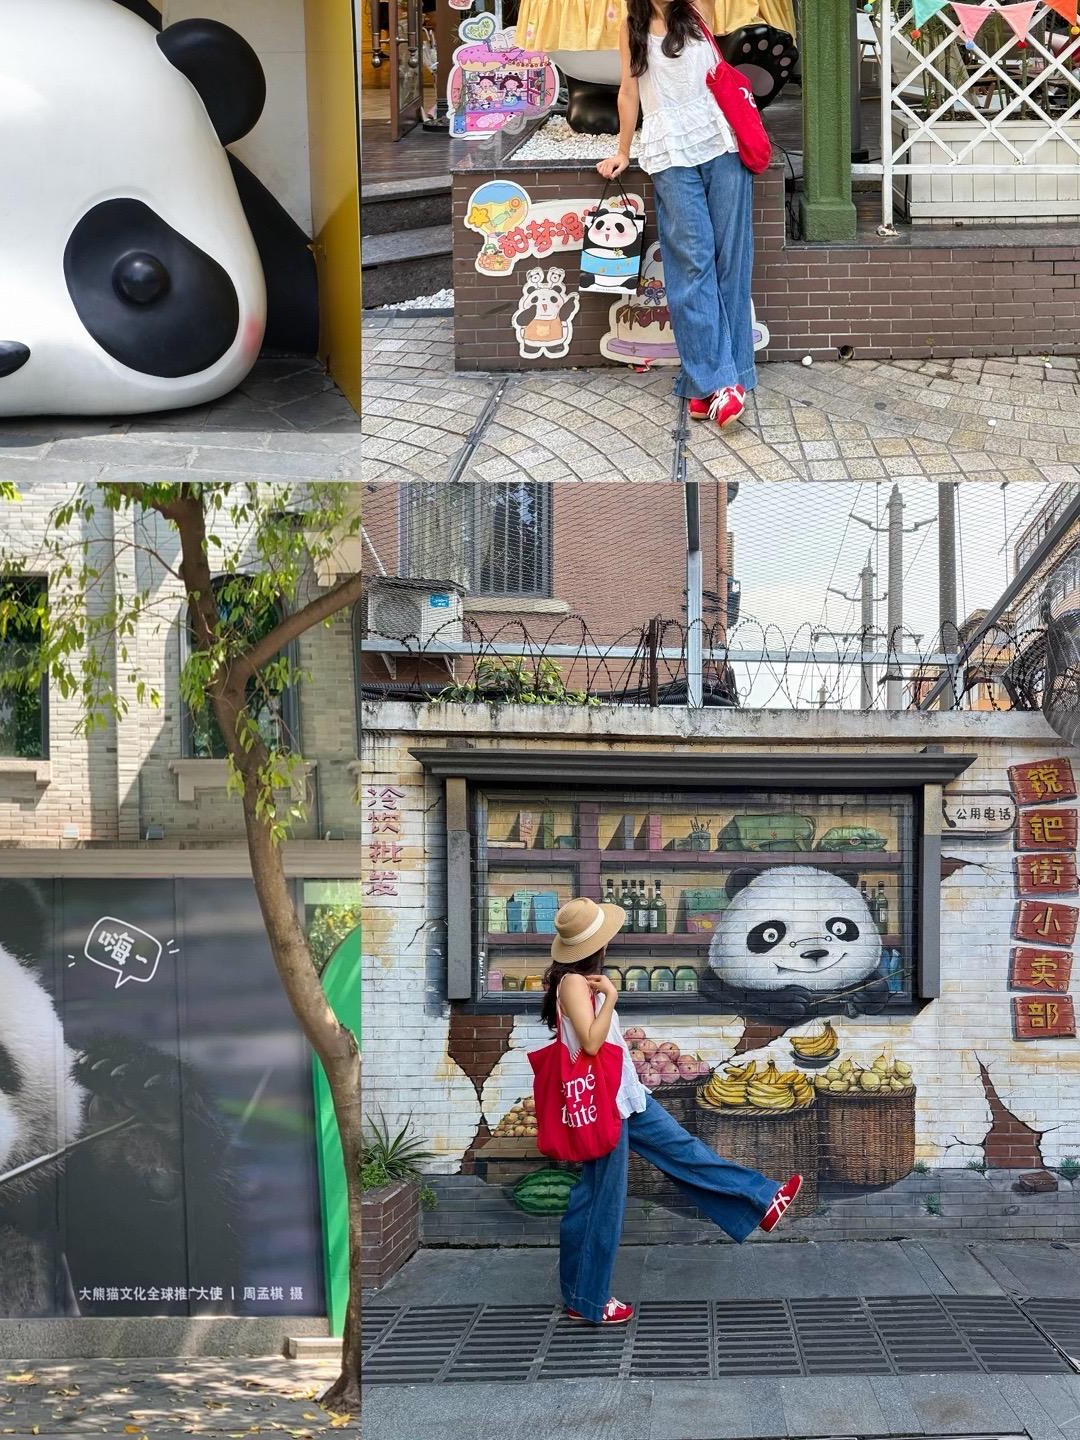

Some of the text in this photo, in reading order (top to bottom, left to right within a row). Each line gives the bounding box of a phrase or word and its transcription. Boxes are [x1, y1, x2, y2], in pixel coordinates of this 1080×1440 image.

[956, 807, 1011, 821] 公用电话
[243, 1286, 283, 1302] 周孟棋
[290, 1286, 303, 1302] 摄
